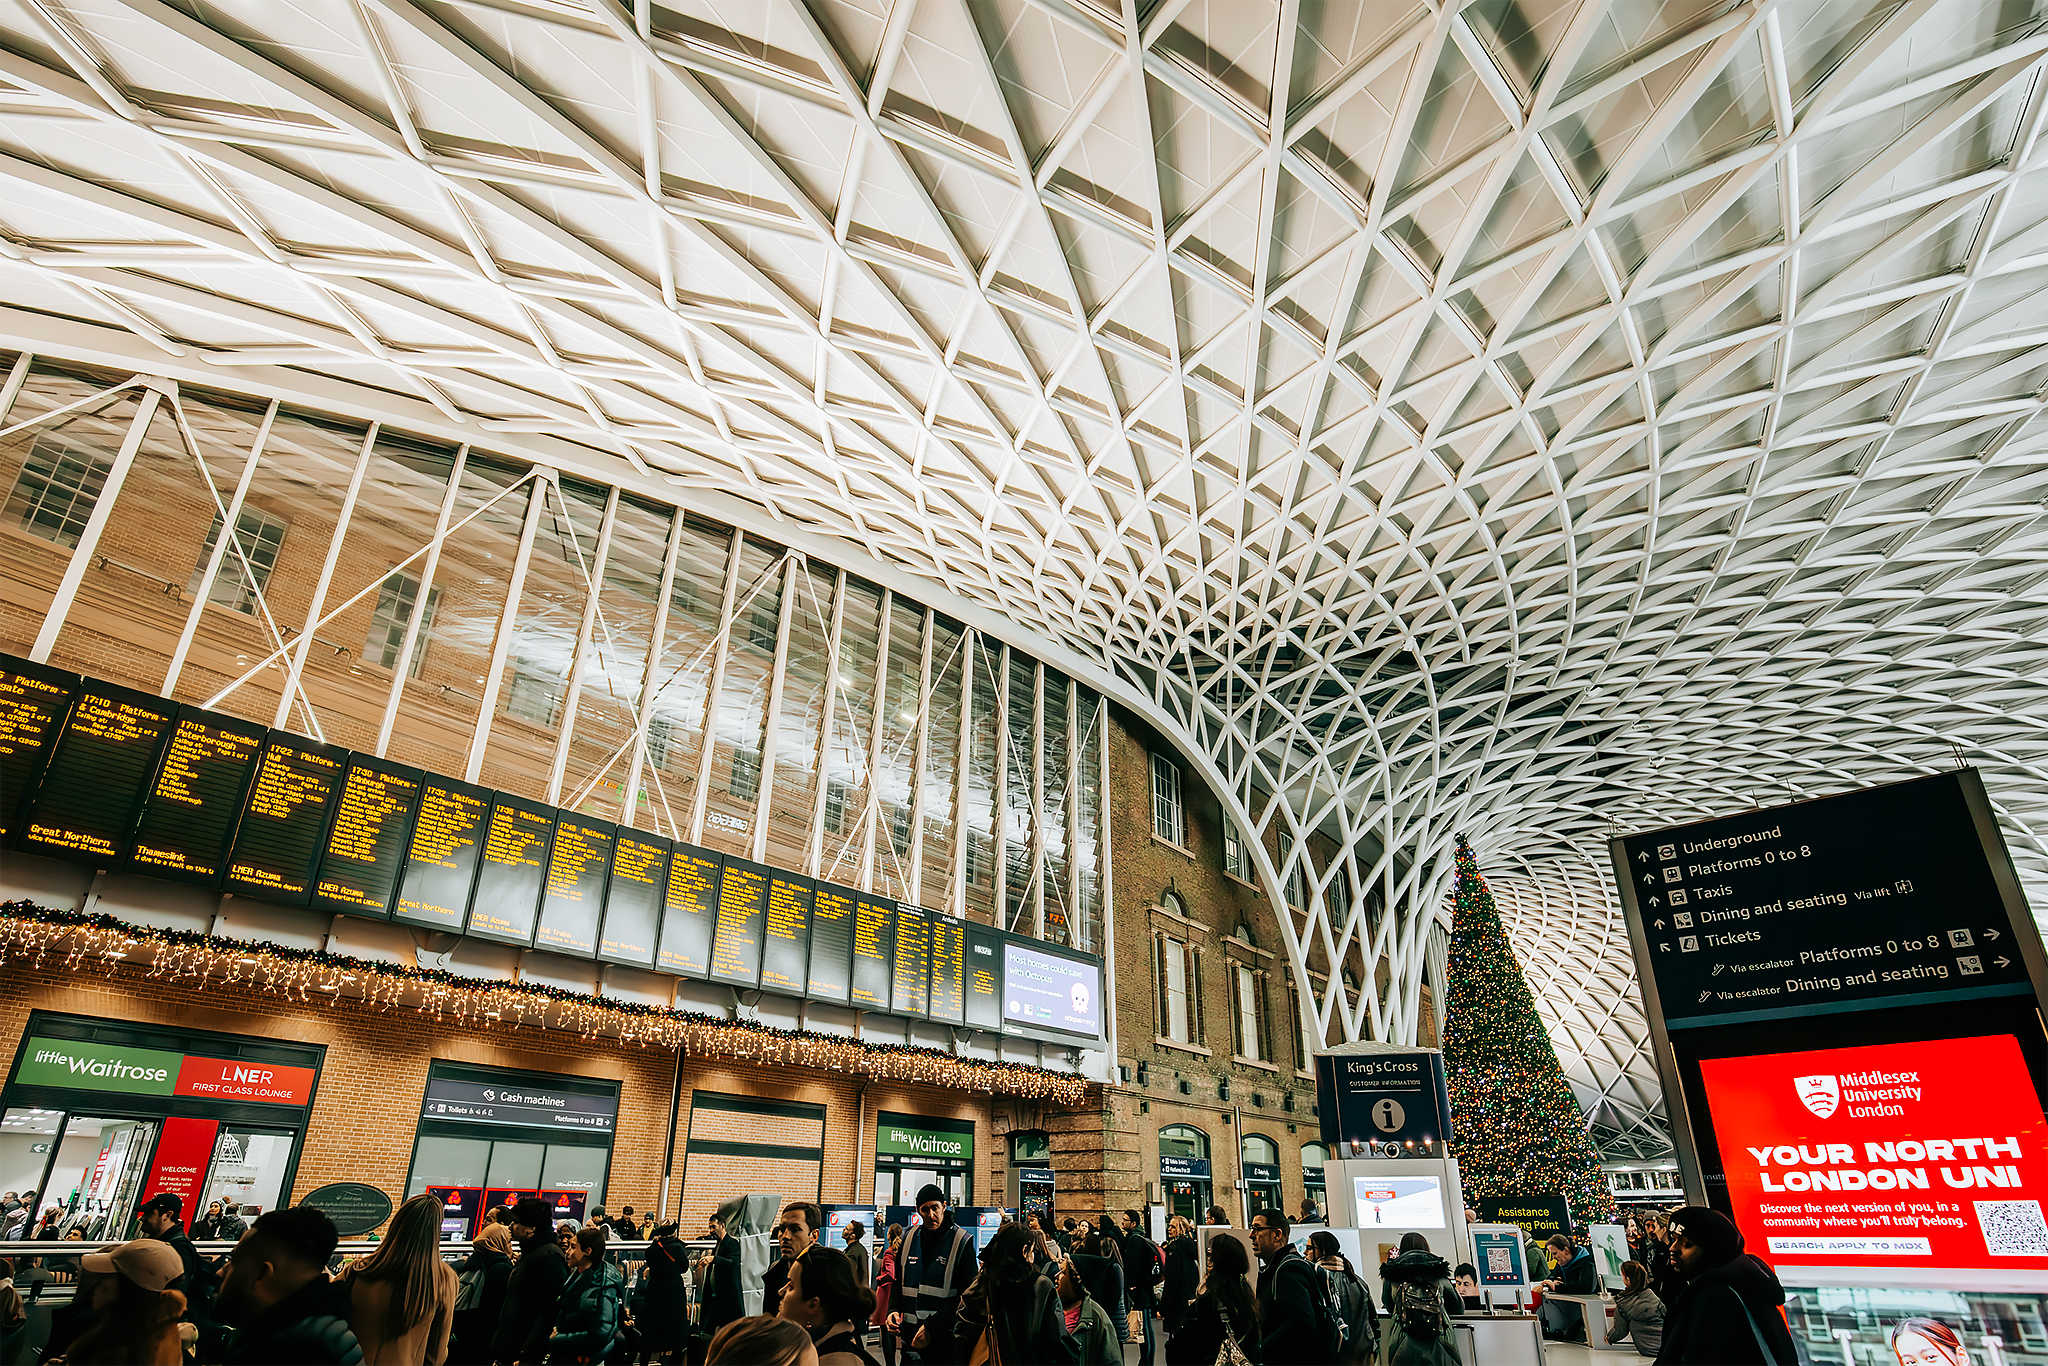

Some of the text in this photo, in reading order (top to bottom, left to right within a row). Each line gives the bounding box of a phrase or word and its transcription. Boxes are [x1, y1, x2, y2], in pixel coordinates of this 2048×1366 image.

[15, 676, 59, 693] Platform
[79, 703, 137, 725] & Cambridge
[120, 704, 159, 720] Platform
[176, 728, 237, 750] Peterborough
[220, 731, 259, 747] Cancelled
[267, 752, 281, 762] Hull
[301, 752, 334, 767] Platform
[349, 775, 385, 789] Edinburgh
[380, 774, 410, 787] Platform
[424, 794, 463, 809] Letchworth
[452, 793, 481, 806] Platform
[494, 812, 513, 823] Leeds
[520, 811, 545, 824] Platform
[31, 824, 111, 847] Great Northern
[1683, 826, 1782, 854] Underground
[136, 846, 186, 862] Thameslink
[1688, 845, 1812, 877] Platforms 0 to 8
[232, 865, 281, 881] LNER Azuma
[319, 882, 338, 892] LNER
[1693, 884, 1733, 900] Taxis
[399, 898, 454, 915] Great Northern
[1700, 888, 1890, 924] Dining and seating Via lift
[1705, 930, 1761, 947] Tickets
[1730, 936, 1940, 973] Via escalator Platforms 0 to 8
[1009, 953, 1082, 978] Most homes could save
[1009, 967, 1052, 983] with Octopus
[1717, 964, 1949, 1000] Via escalator Dining and seating
[34, 1050, 168, 1082] little Waitrose
[1348, 1061, 1418, 1076] King's Cross
[221, 1065, 274, 1084] LNER
[1840, 1070, 1920, 1088] Middlesex
[192, 1082, 293, 1098] FIRST CLASS LOUNGE
[1843, 1085, 1921, 1102] University
[500, 1092, 566, 1108] Cash machines
[448, 1106, 468, 1114] Toilets
[554, 1115, 580, 1124] Platforms
[1848, 1103, 1904, 1118] London
[890, 1130, 962, 1154] little Waitrose
[1746, 1137, 2022, 1167] YOUR NORTH
[1759, 1166, 2022, 1193] LONDON UNI
[1498, 1207, 1550, 1217] Assistance
[1760, 1202, 1960, 1214] Discover the next version of you, in a
[1534, 1220, 1559, 1230] Point
[1763, 1216, 1968, 1228] community where you'll truly belong.
[1774, 1242, 1924, 1250] SEARCH APPLY TO MDX
